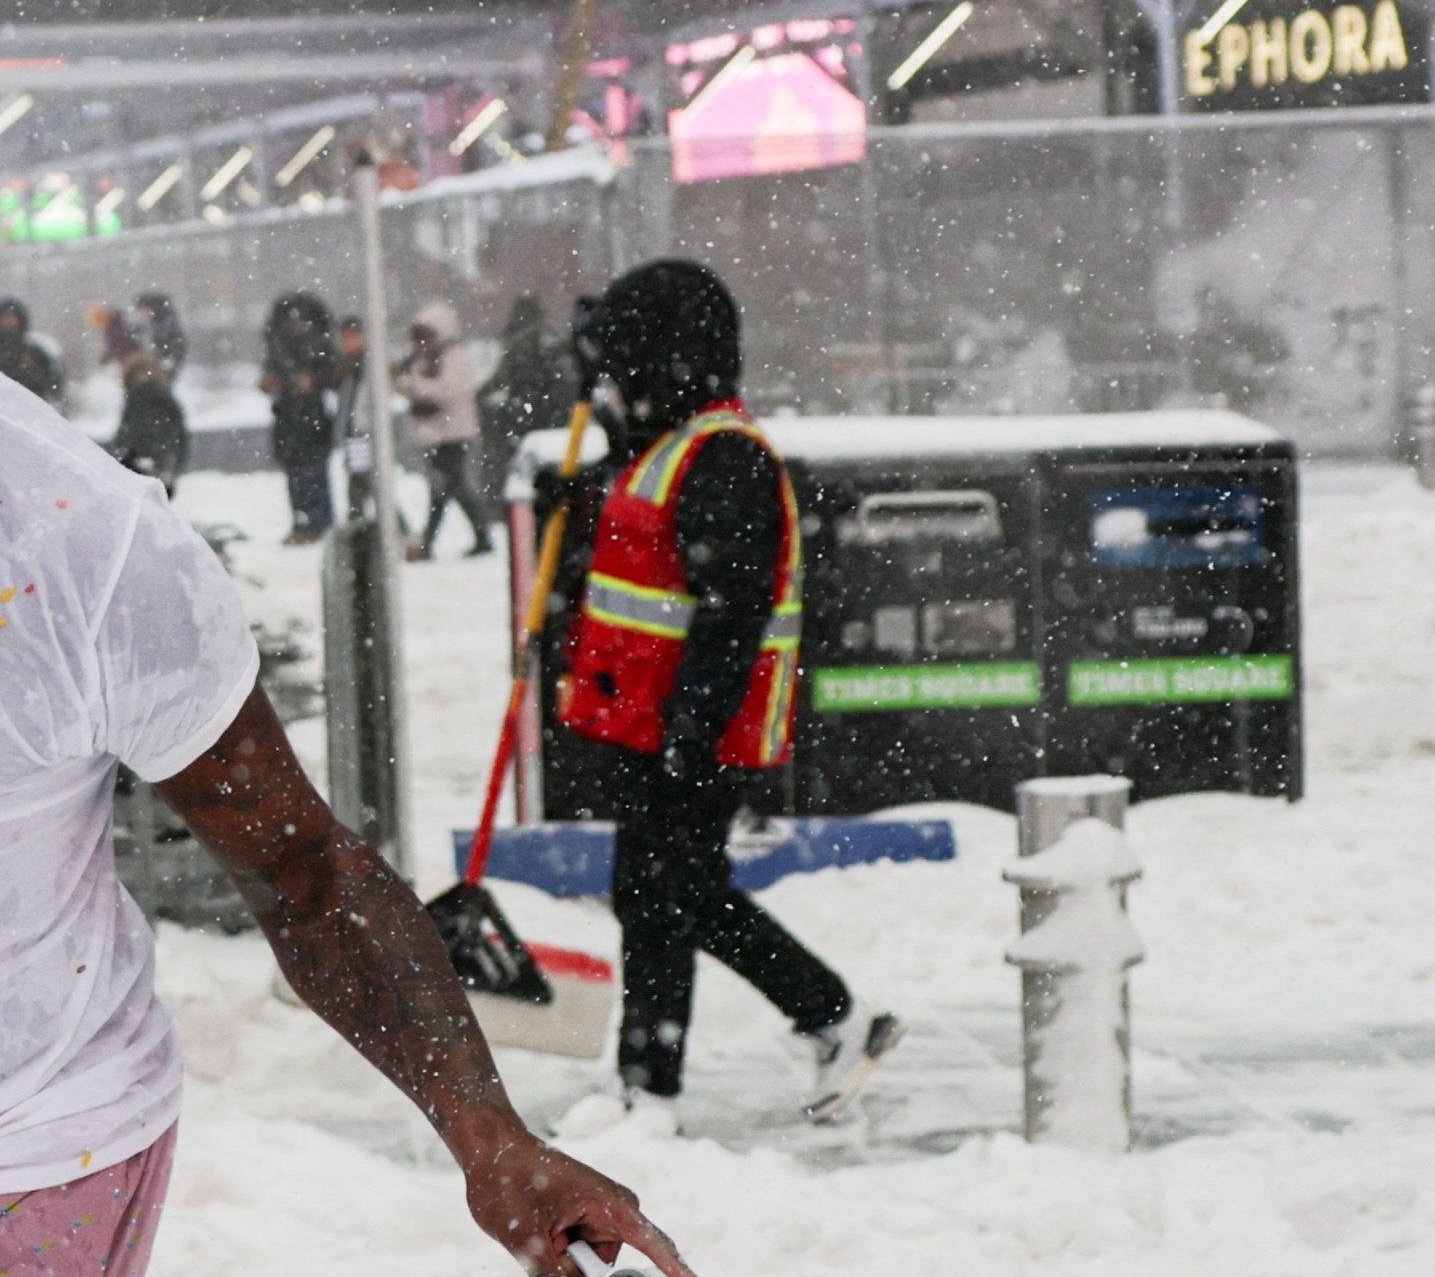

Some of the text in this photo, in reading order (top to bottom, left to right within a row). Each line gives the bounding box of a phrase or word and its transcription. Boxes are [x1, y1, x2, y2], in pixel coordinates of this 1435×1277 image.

[824, 671, 1031, 702] TIMES SQUARE
[1077, 666, 1284, 697] TIMES SQUARE
